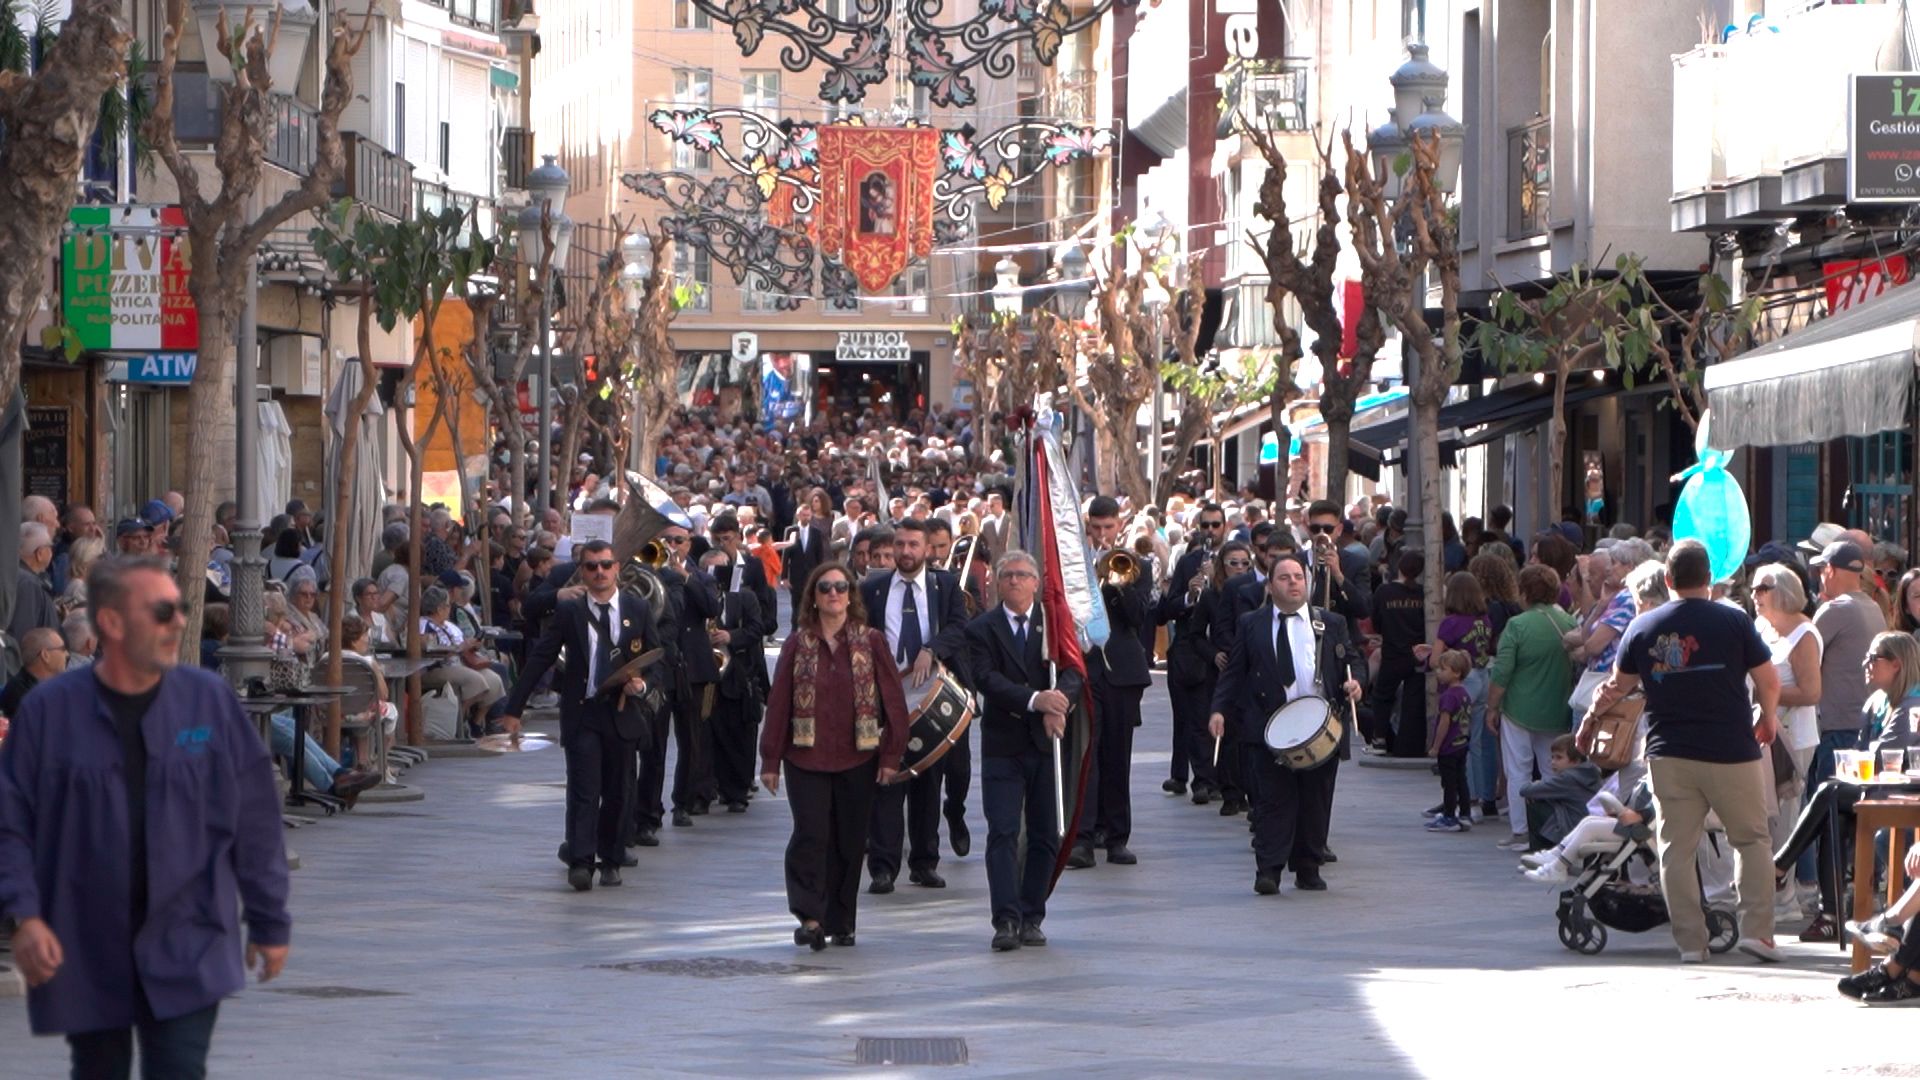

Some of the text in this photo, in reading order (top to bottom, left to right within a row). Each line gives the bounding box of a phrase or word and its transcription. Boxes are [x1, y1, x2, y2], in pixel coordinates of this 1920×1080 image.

[1860, 187, 1916, 195] ENTREPLANTA
[74, 232, 192, 270] DIVA
[87, 313, 186, 325] NAPOLITANA
[838, 332, 909, 346] FUTBOL
[838, 347, 909, 359] FACTORY
[140, 354, 197, 377] ATM
